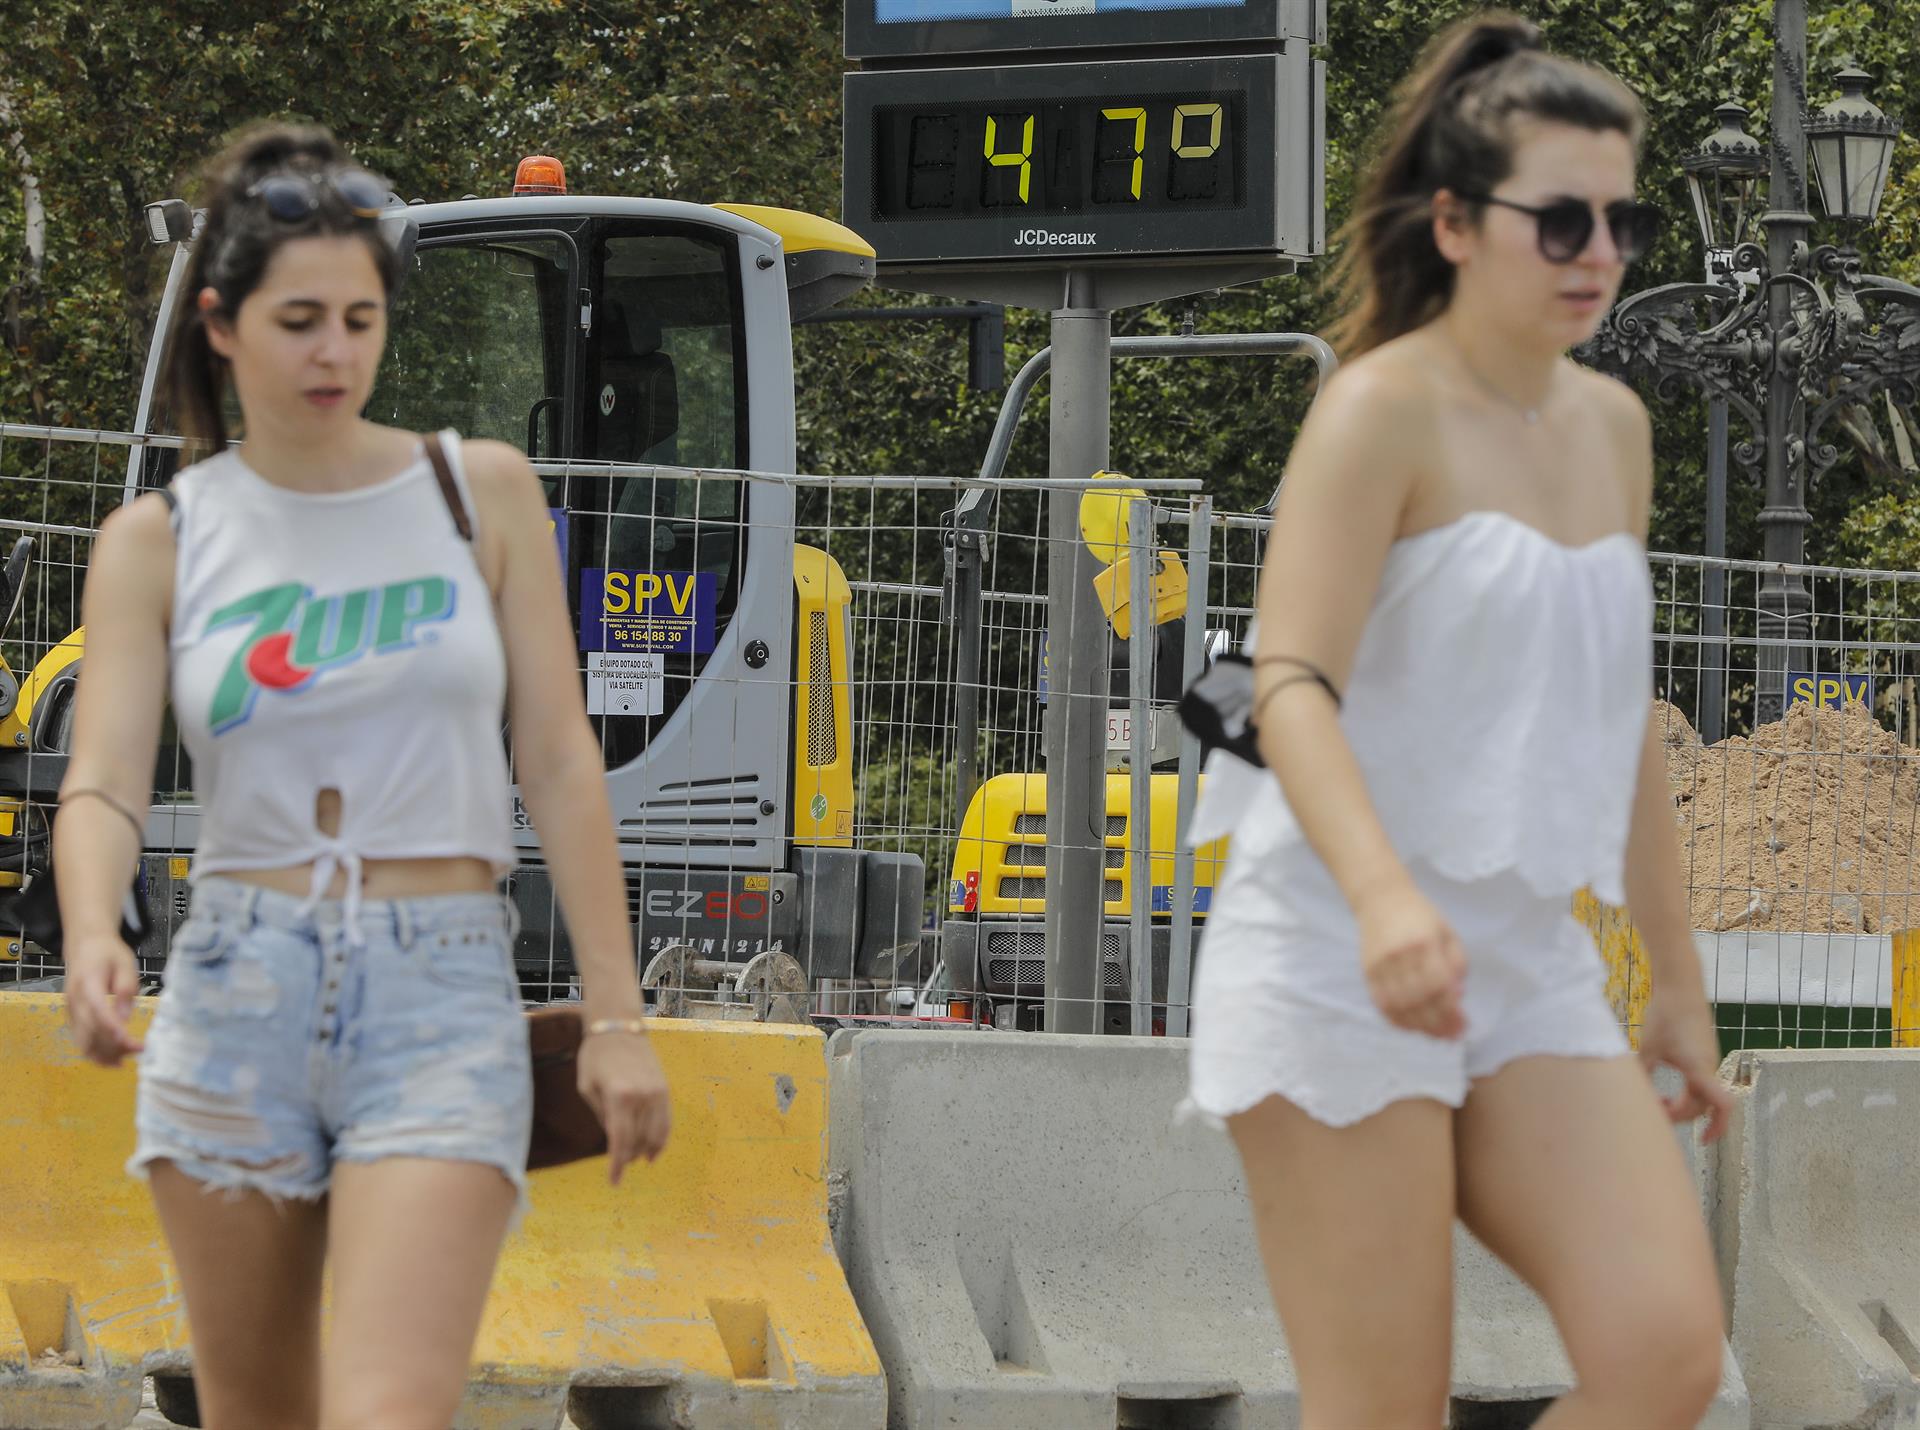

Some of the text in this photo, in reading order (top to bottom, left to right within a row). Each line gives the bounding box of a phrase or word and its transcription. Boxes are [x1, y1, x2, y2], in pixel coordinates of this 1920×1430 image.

[1014, 229, 1097, 246] JCDecaux
[602, 571, 696, 616] SPV
[614, 630, 682, 642] 96 154 88 30
[600, 659, 619, 668] EUIPO
[620, 660, 641, 668] DOTADO
[609, 681, 643, 690] VIA SATELITE
[1793, 678, 1867, 711] SPV
[646, 889, 768, 920] EZ80
